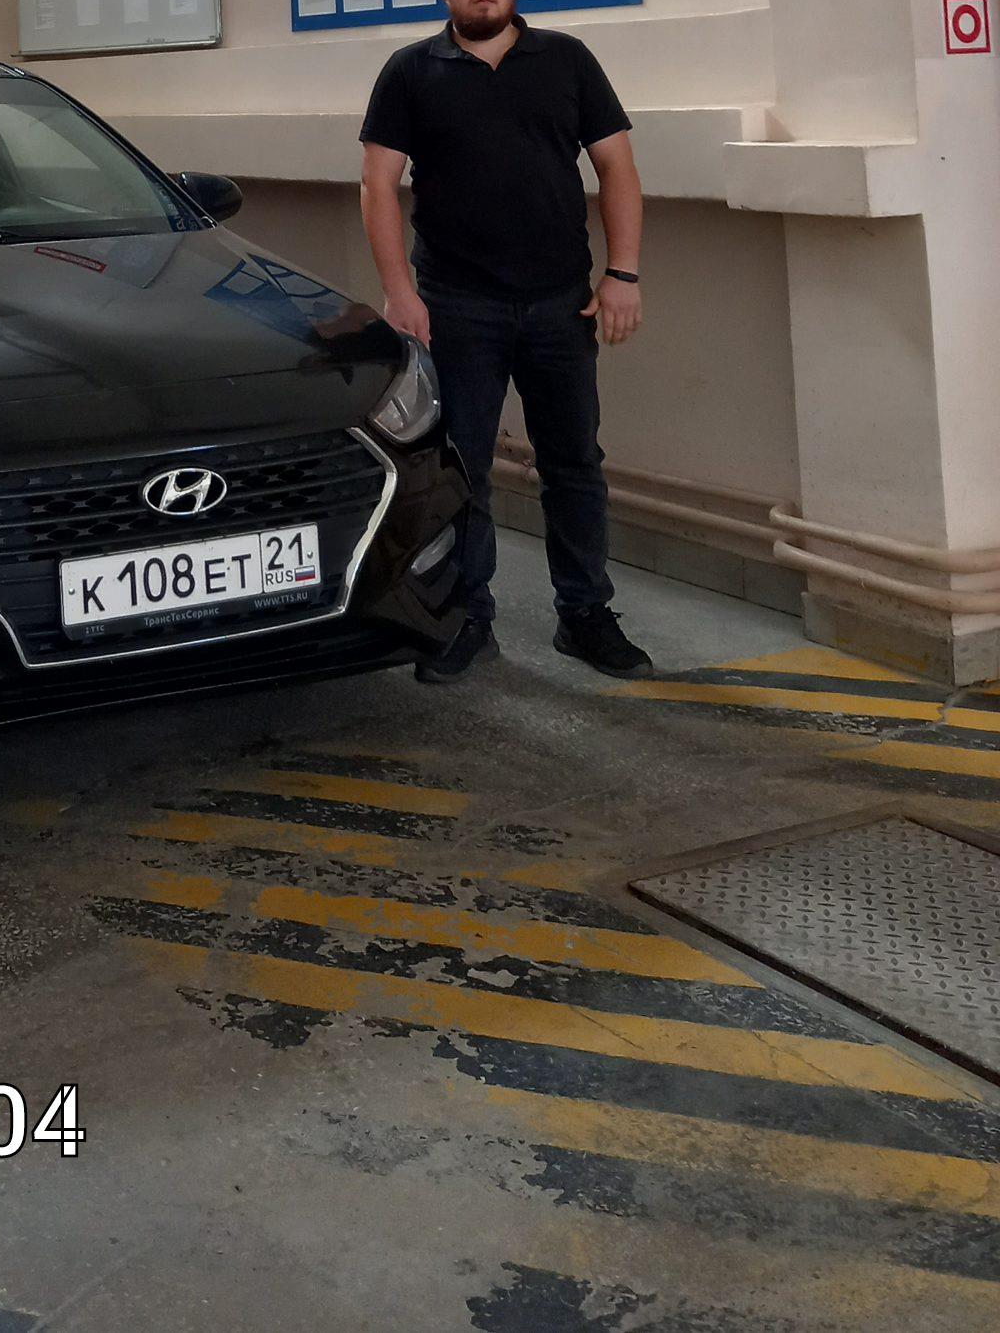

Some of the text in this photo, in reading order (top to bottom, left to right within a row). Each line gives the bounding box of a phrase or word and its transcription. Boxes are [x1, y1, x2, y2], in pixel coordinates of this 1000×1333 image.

[266, 532, 304, 571] 21
[265, 569, 294, 586] RUS
[143, 607, 220, 628] ТрансТехСервис
